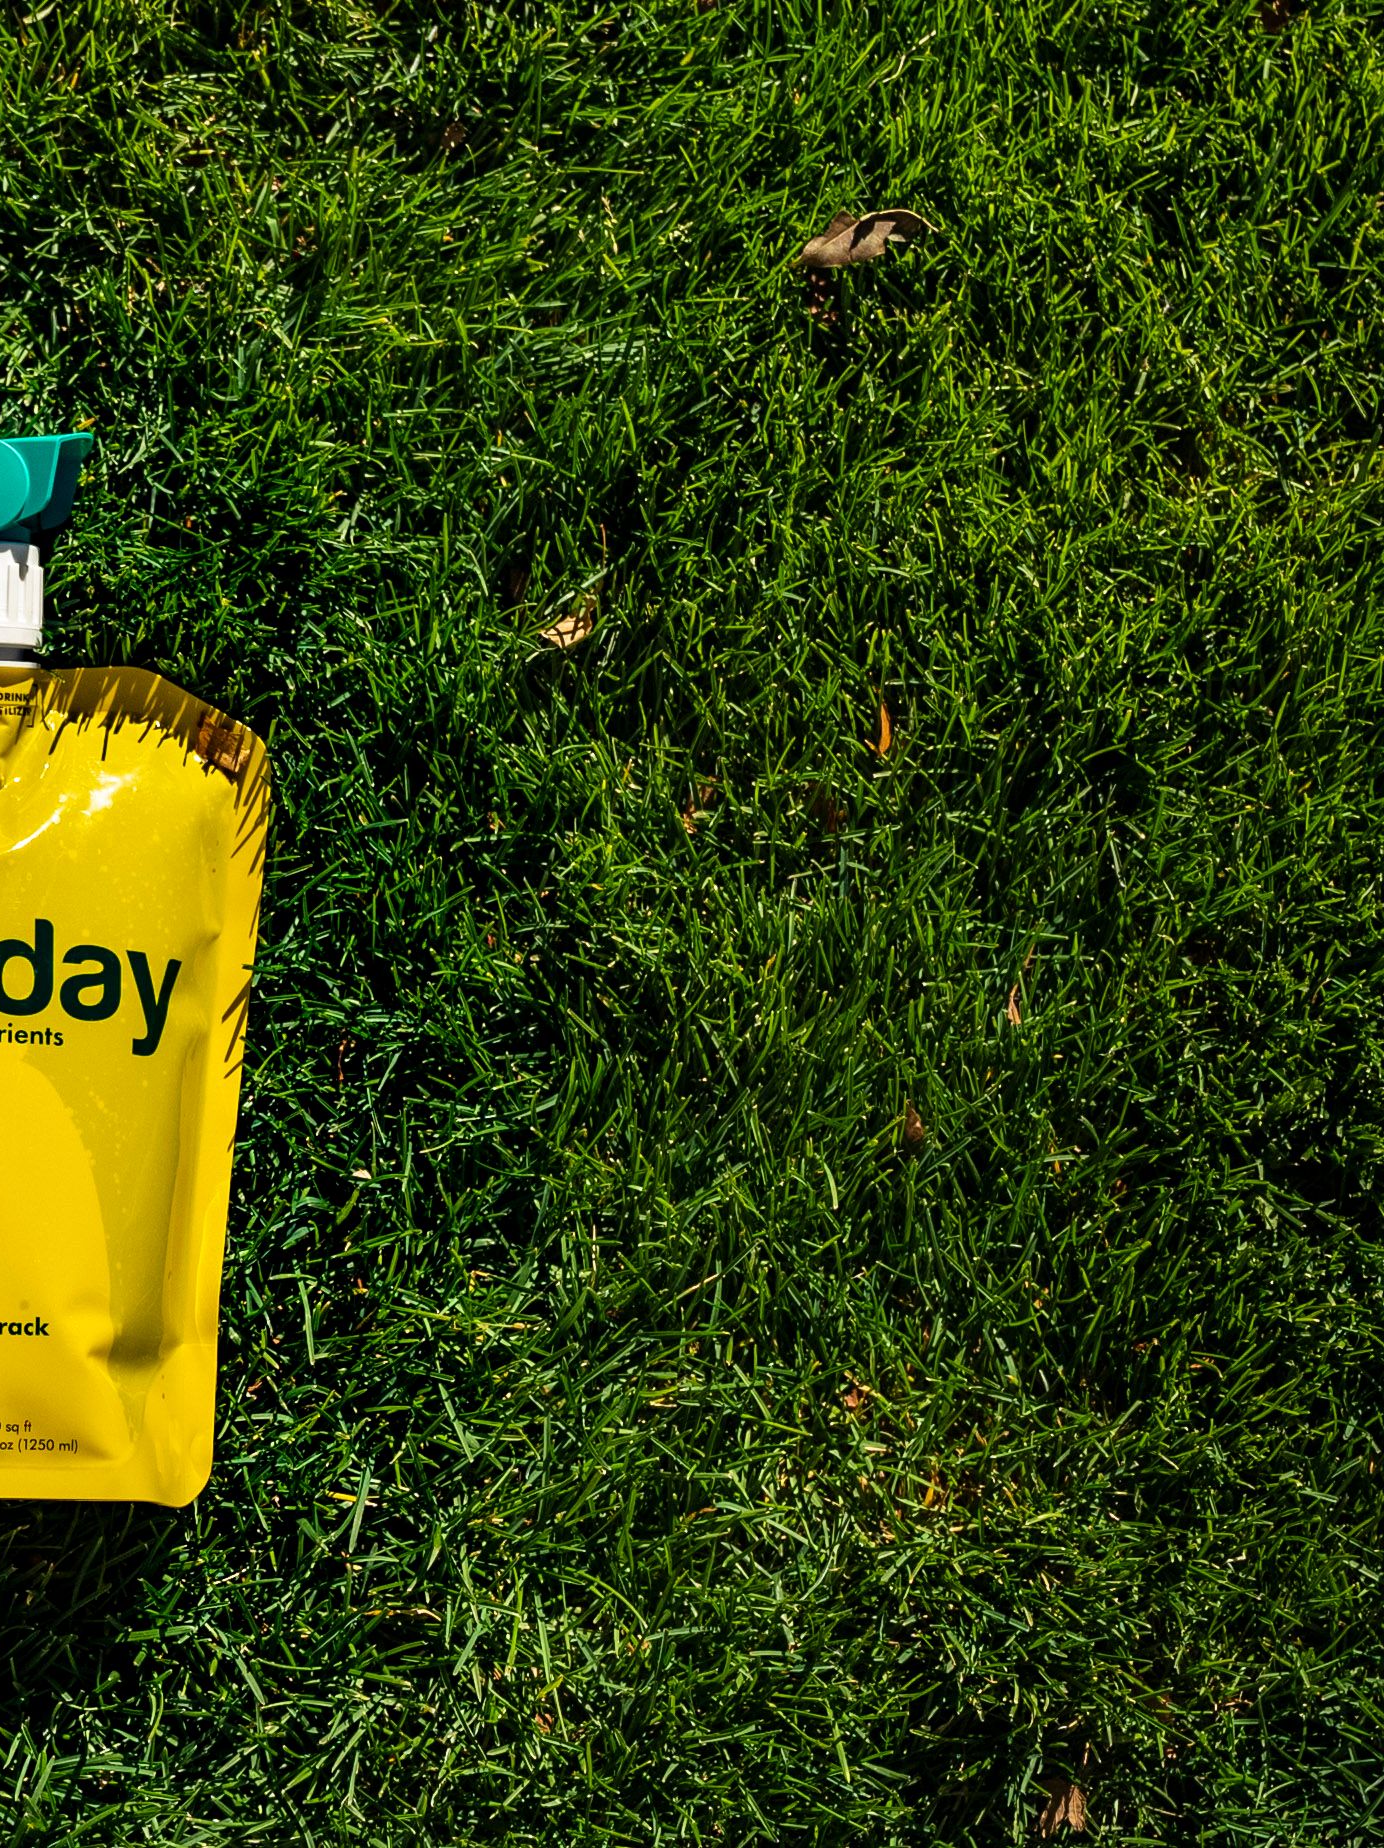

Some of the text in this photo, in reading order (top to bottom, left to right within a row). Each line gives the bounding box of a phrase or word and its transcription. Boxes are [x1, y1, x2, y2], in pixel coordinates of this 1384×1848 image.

[5, 1423, 20, 1435] sq
[23, 1419, 32, 1433] ft
[0, 1440, 14, 1451] oz
[17, 1438, 55, 1453] (1250
[58, 1439, 79, 1454] ml)
